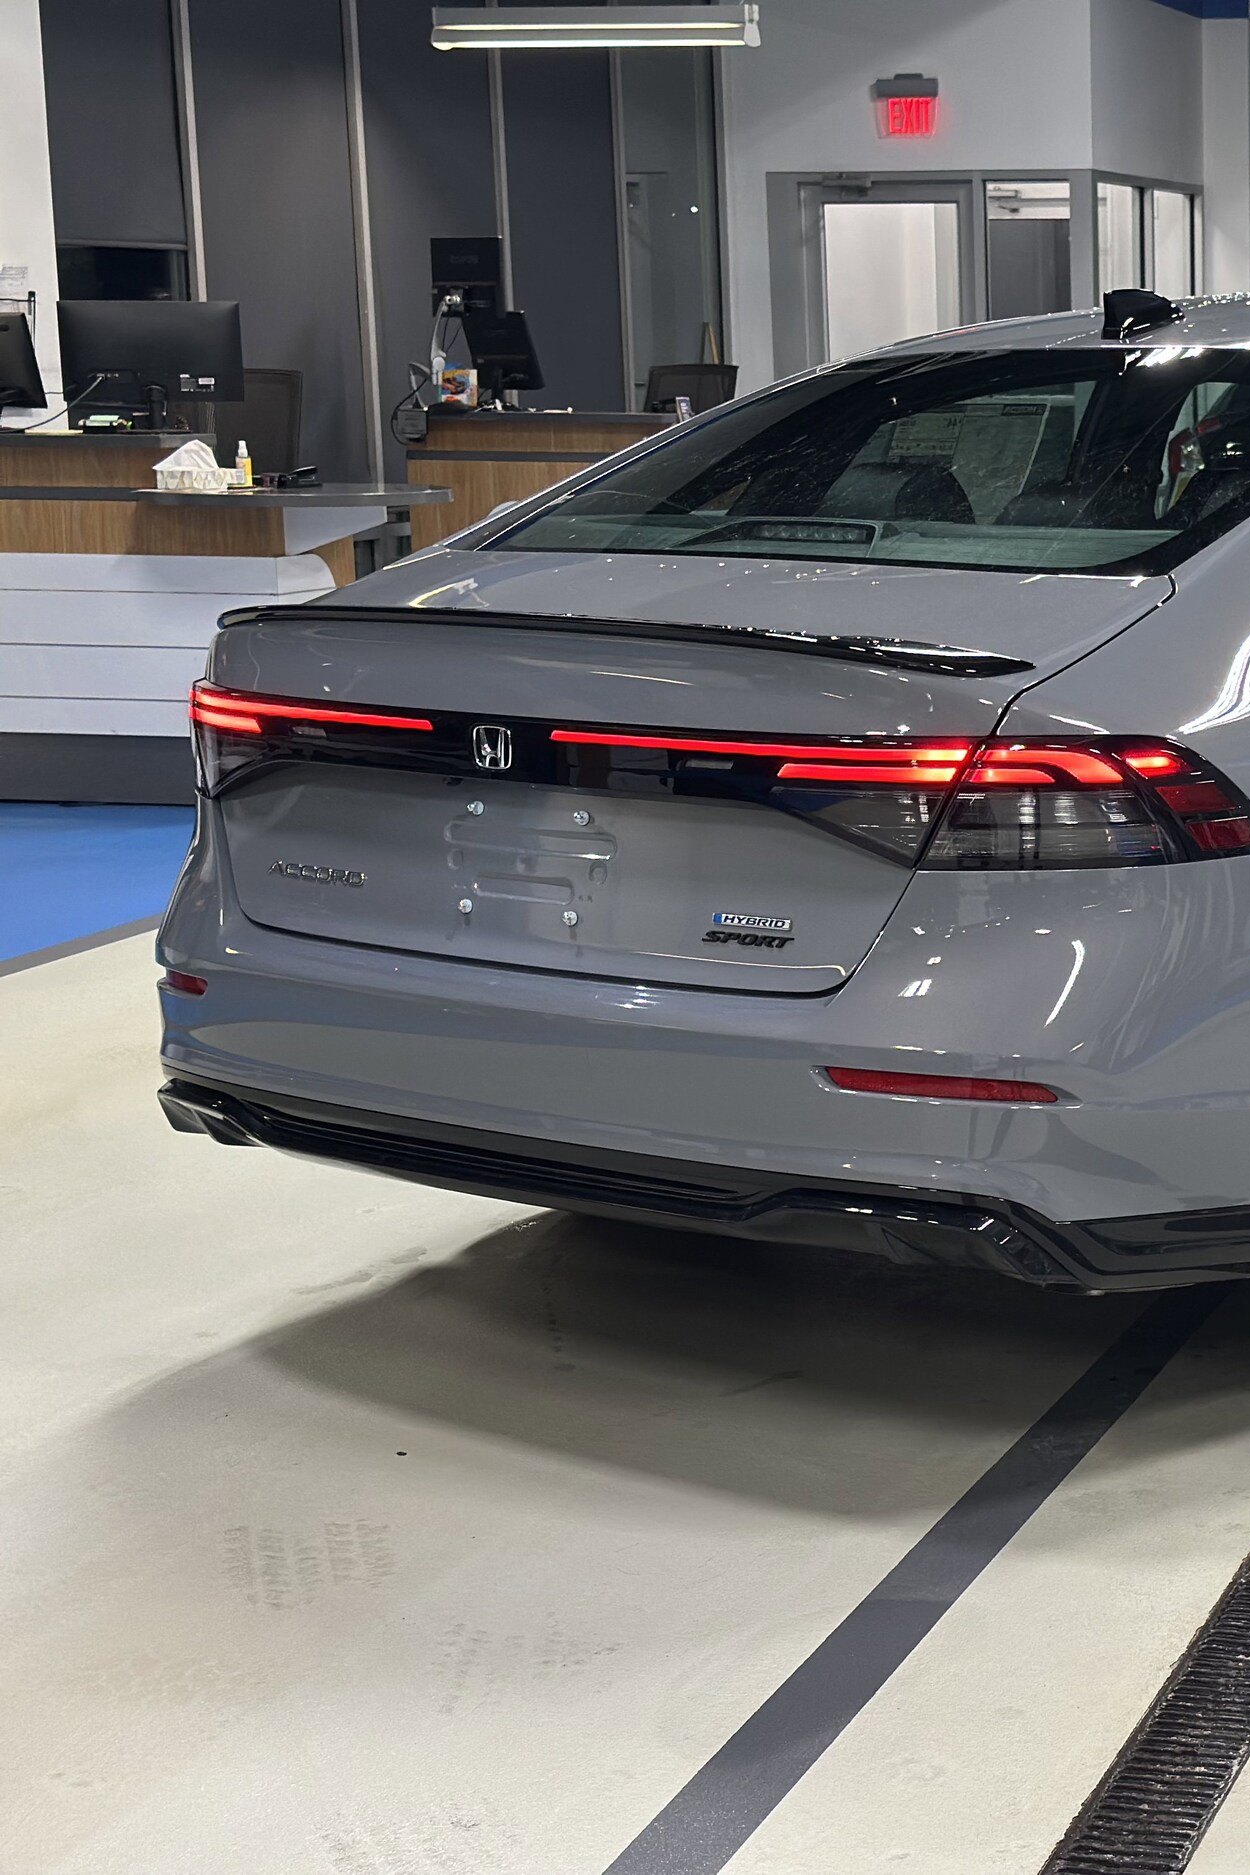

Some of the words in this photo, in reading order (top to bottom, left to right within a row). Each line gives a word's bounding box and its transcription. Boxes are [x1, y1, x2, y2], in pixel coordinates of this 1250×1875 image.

[888, 97, 932, 134] EXIT
[267, 860, 367, 887] ACCORD
[722, 915, 787, 929] HYBRID
[701, 930, 795, 949] SPORT
